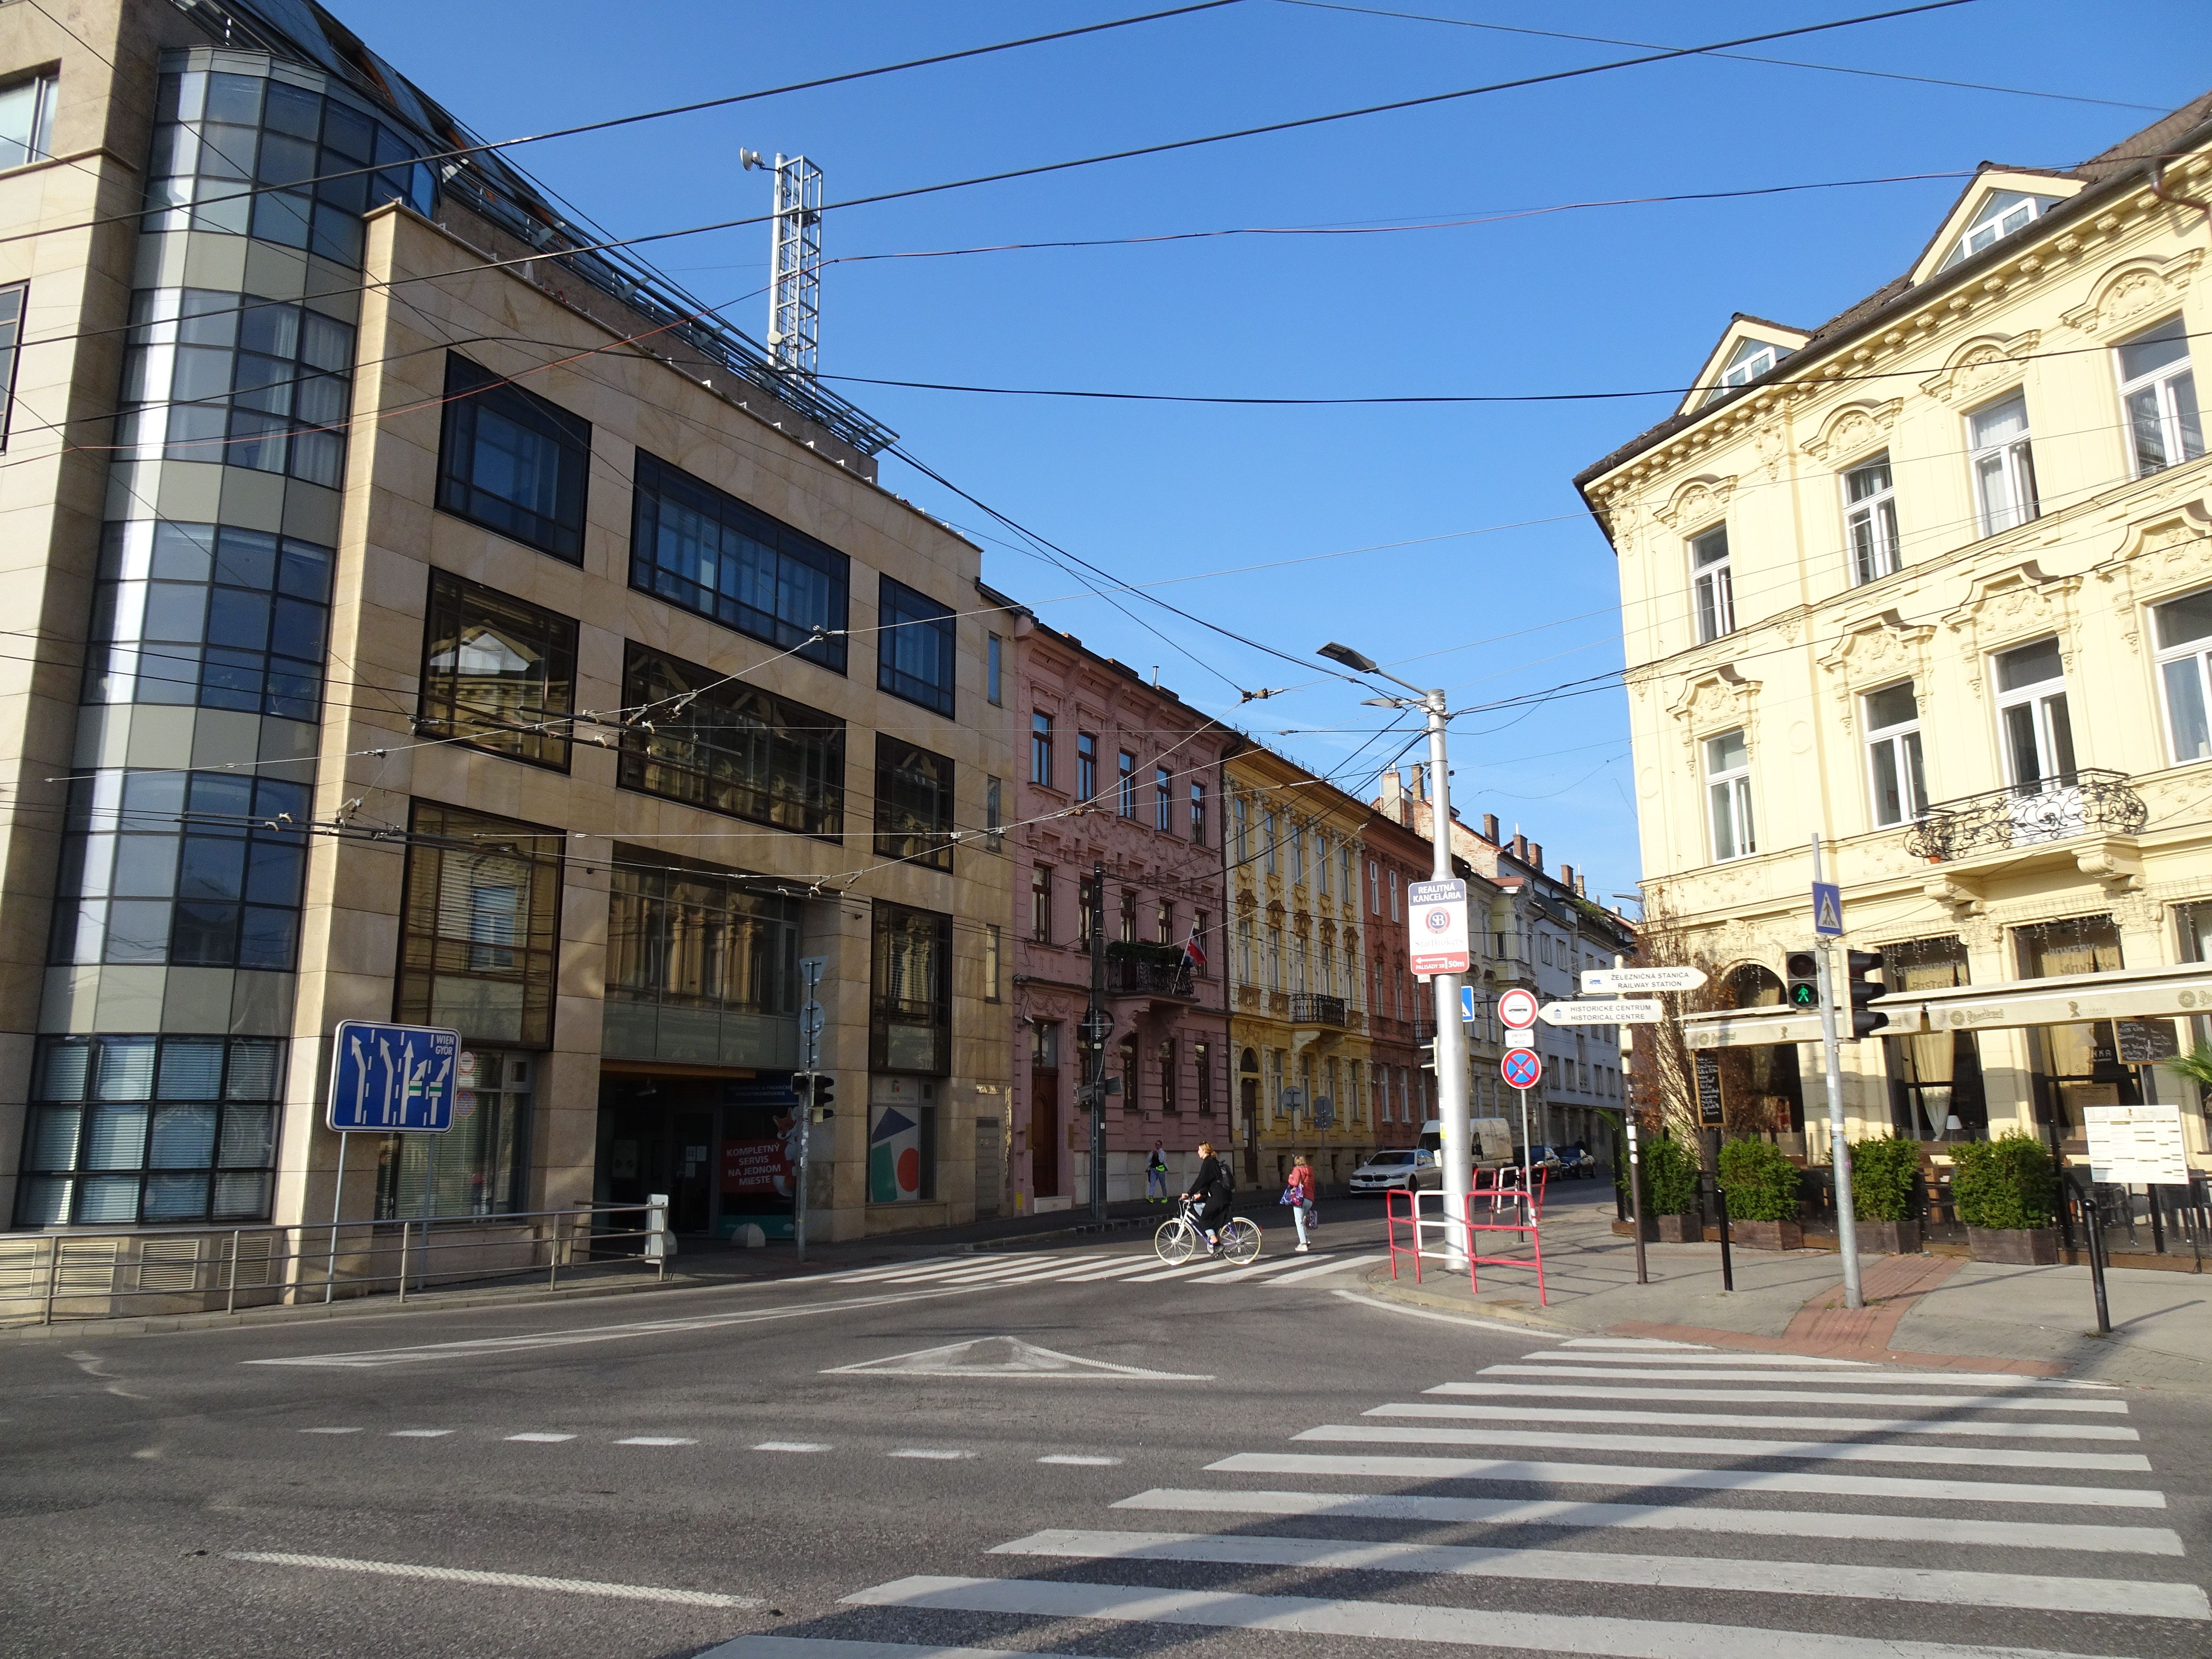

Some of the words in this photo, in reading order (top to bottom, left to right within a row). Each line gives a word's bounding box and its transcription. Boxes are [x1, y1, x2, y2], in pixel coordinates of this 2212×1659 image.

[1418, 882, 1455, 894] REALITNÁ
[1413, 891, 1461, 903] KANCELÁRIA
[1432, 914, 1445, 926] SB
[1415, 938, 1463, 947] StarBrokers
[1611, 972, 1655, 980] ŽELEZNIČNÁ
[436, 1035, 455, 1045] WIEN
[726, 1142, 780, 1157] KOMPLETNÝ
[739, 1155, 769, 1166] SERVIS
[728, 1168, 741, 1177] NA
[743, 1164, 781, 1176] JEDNOM
[739, 1175, 771, 1186] MIESTE
